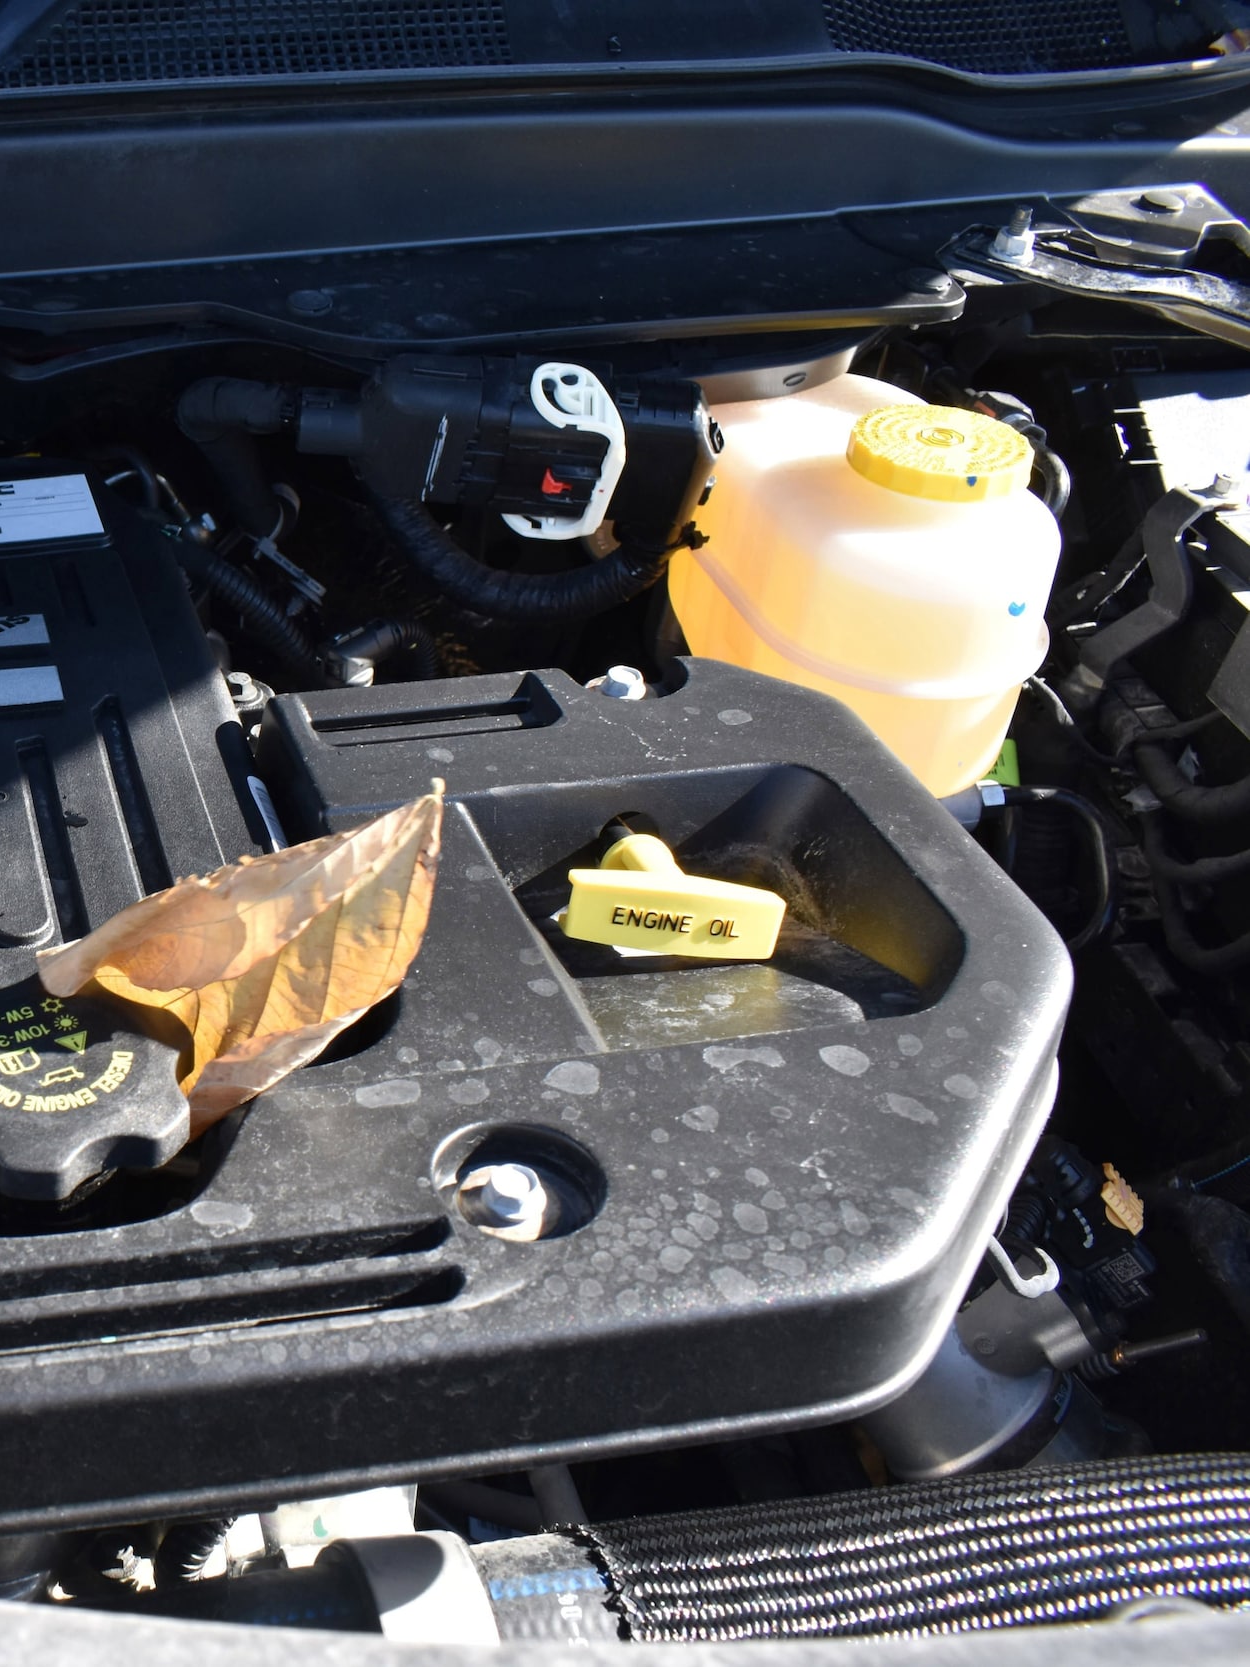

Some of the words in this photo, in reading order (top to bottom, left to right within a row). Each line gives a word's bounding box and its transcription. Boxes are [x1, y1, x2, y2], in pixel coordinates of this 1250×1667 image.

[611, 906, 693, 934] ENGINE
[709, 918, 739, 938] OIL
[90, 1050, 134, 1094] DIESEL
[22, 1087, 98, 1112] ENGINE
